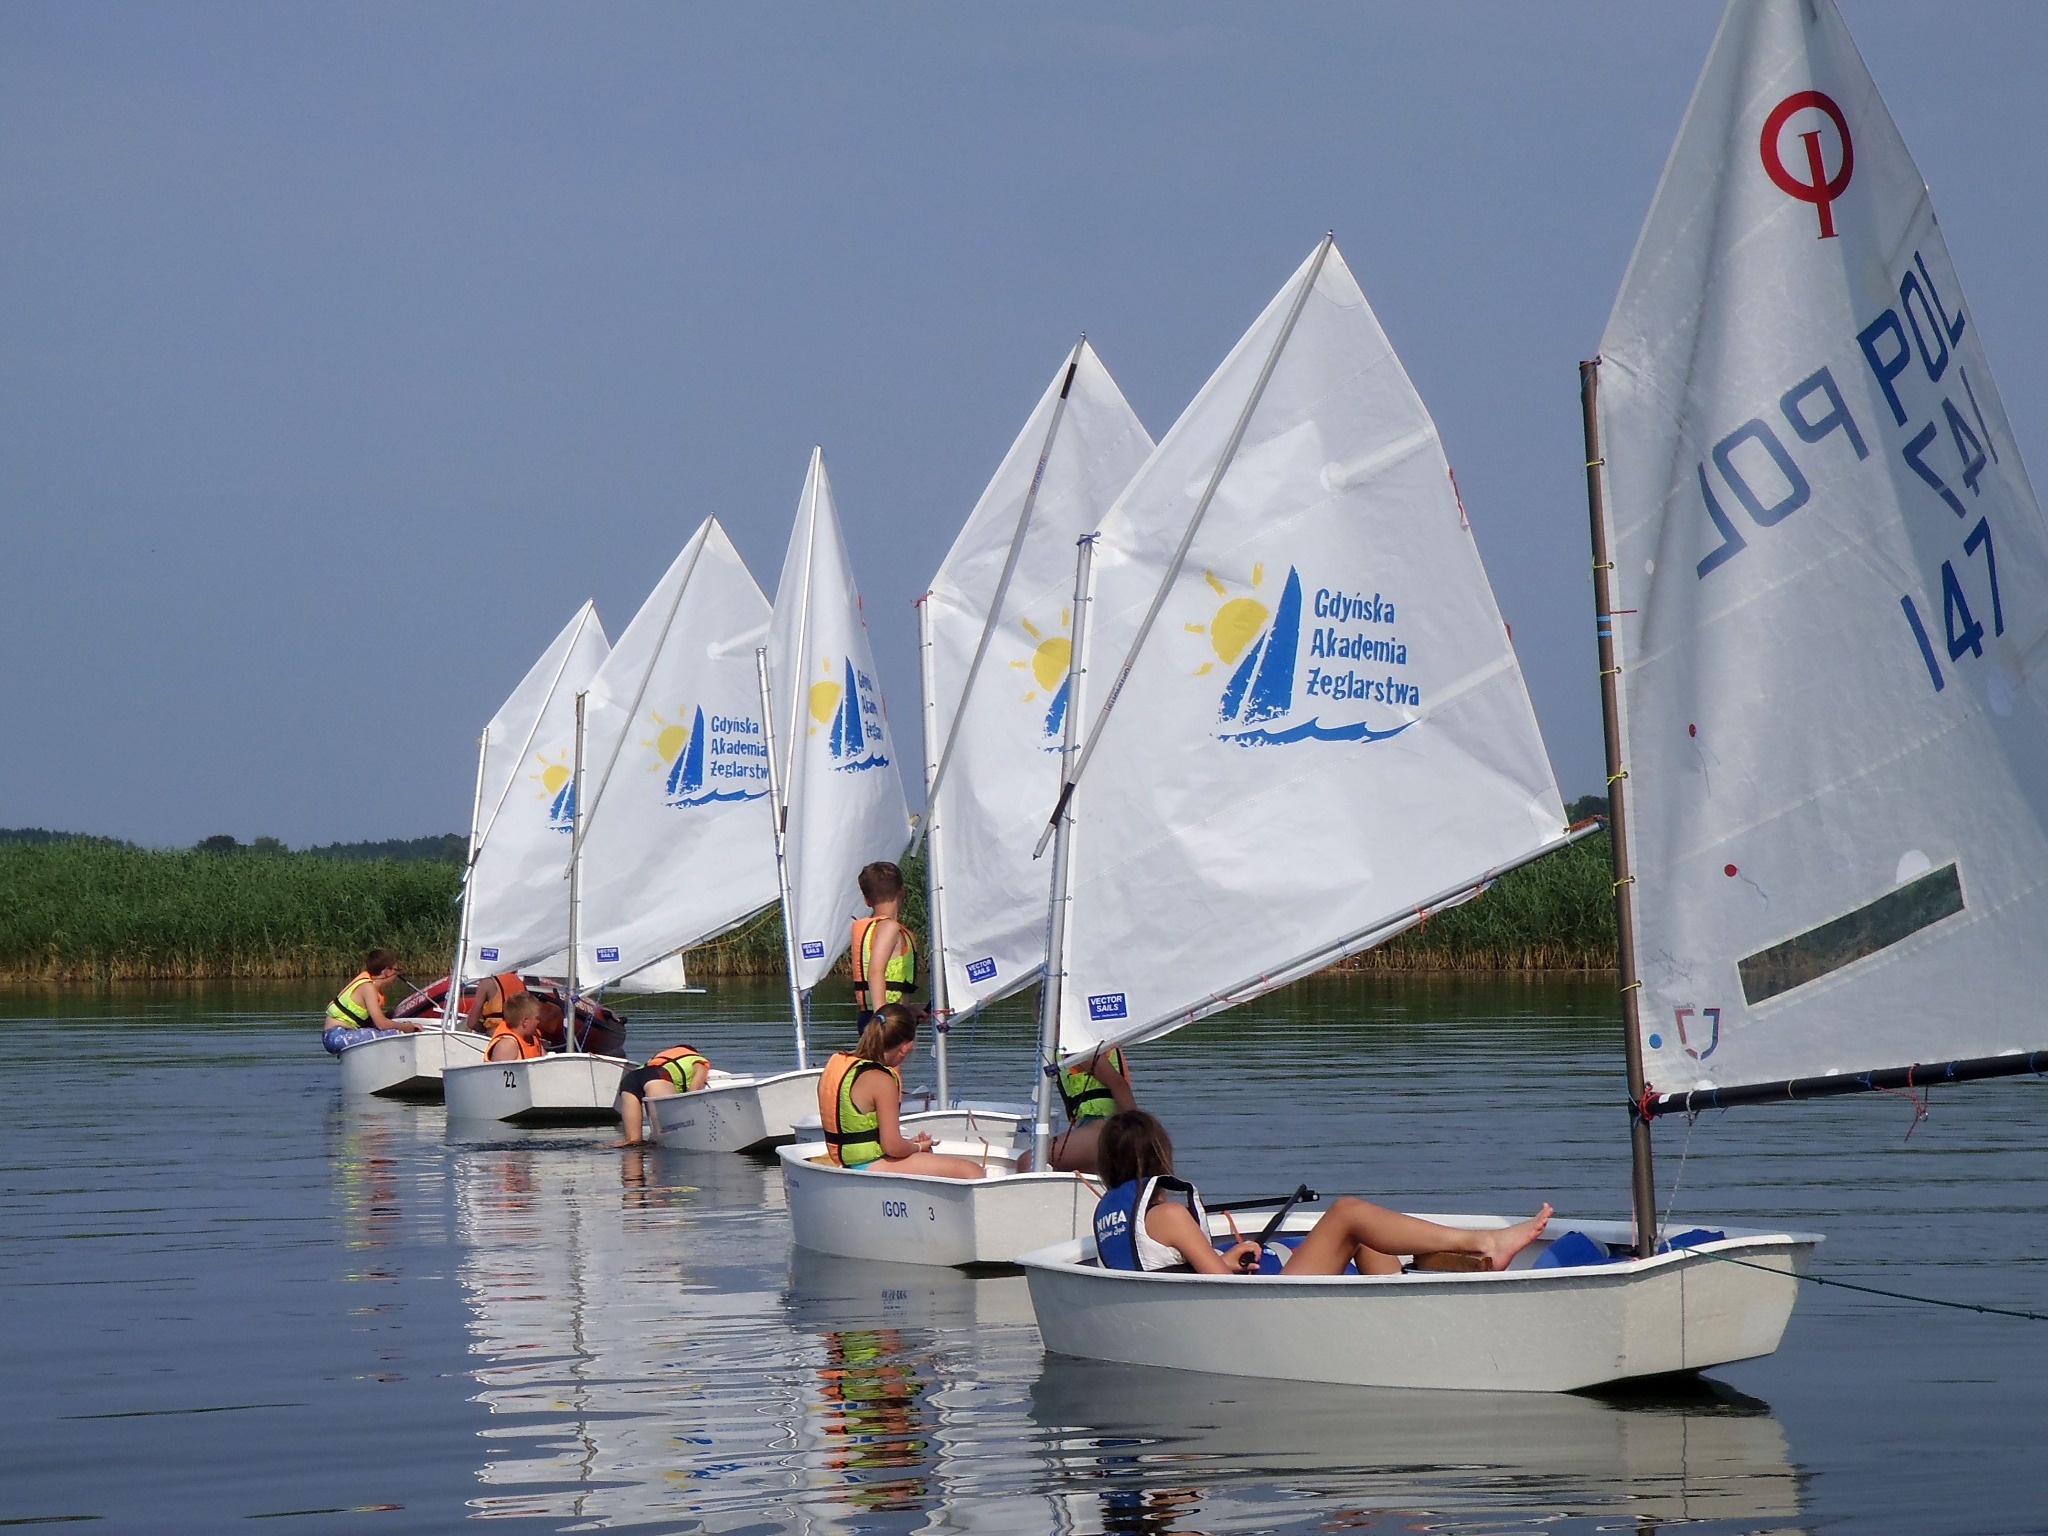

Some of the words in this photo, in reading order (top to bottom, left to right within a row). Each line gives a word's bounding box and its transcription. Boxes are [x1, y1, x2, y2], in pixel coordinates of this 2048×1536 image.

[1856, 250, 1966, 427] POL
[1314, 588, 1395, 624] Gdyńska
[1900, 516, 2004, 692] 147
[1309, 628, 1407, 665] Akademia
[711, 715, 759, 735] Gdyńska
[711, 737, 768, 757] Akademia
[710, 760, 769, 780] Żeglarstw
[968, 959, 992, 971] VECTOR
[973, 966, 990, 977] SAILS
[1090, 995, 1123, 1006] VECTOR
[1096, 1003, 1119, 1012] SAILS
[503, 1070, 517, 1088] 22
[882, 1200, 908, 1218] IGOR
[928, 1206, 935, 1221] 3
[1096, 1209, 1127, 1234] NIVEA
